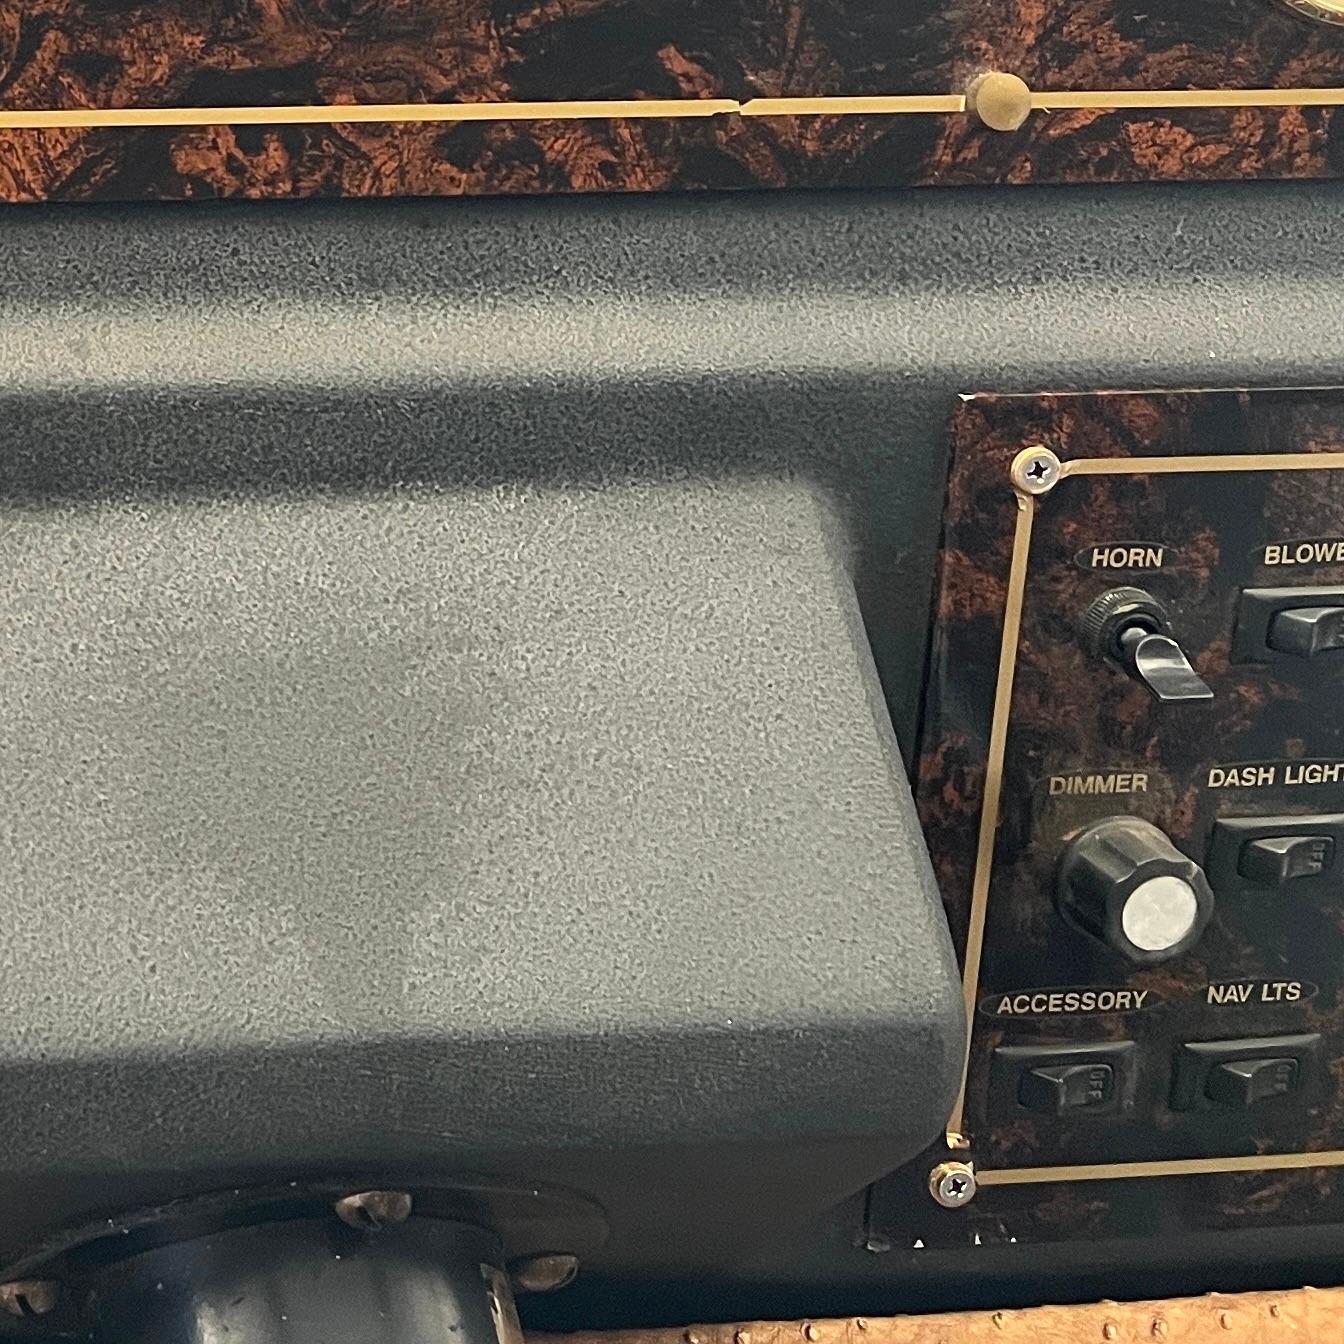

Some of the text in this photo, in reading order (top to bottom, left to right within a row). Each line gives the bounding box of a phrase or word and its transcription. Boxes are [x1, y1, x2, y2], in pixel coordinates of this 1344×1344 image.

[1091, 547, 1163, 568] HORN
[1264, 541, 1344, 565] BLOWE
[1049, 773, 1149, 795] DIMMER
[1208, 766, 1275, 788] DASH
[997, 990, 1148, 1014] ACCESSORY
[1207, 981, 1302, 1004] NAV LTS
